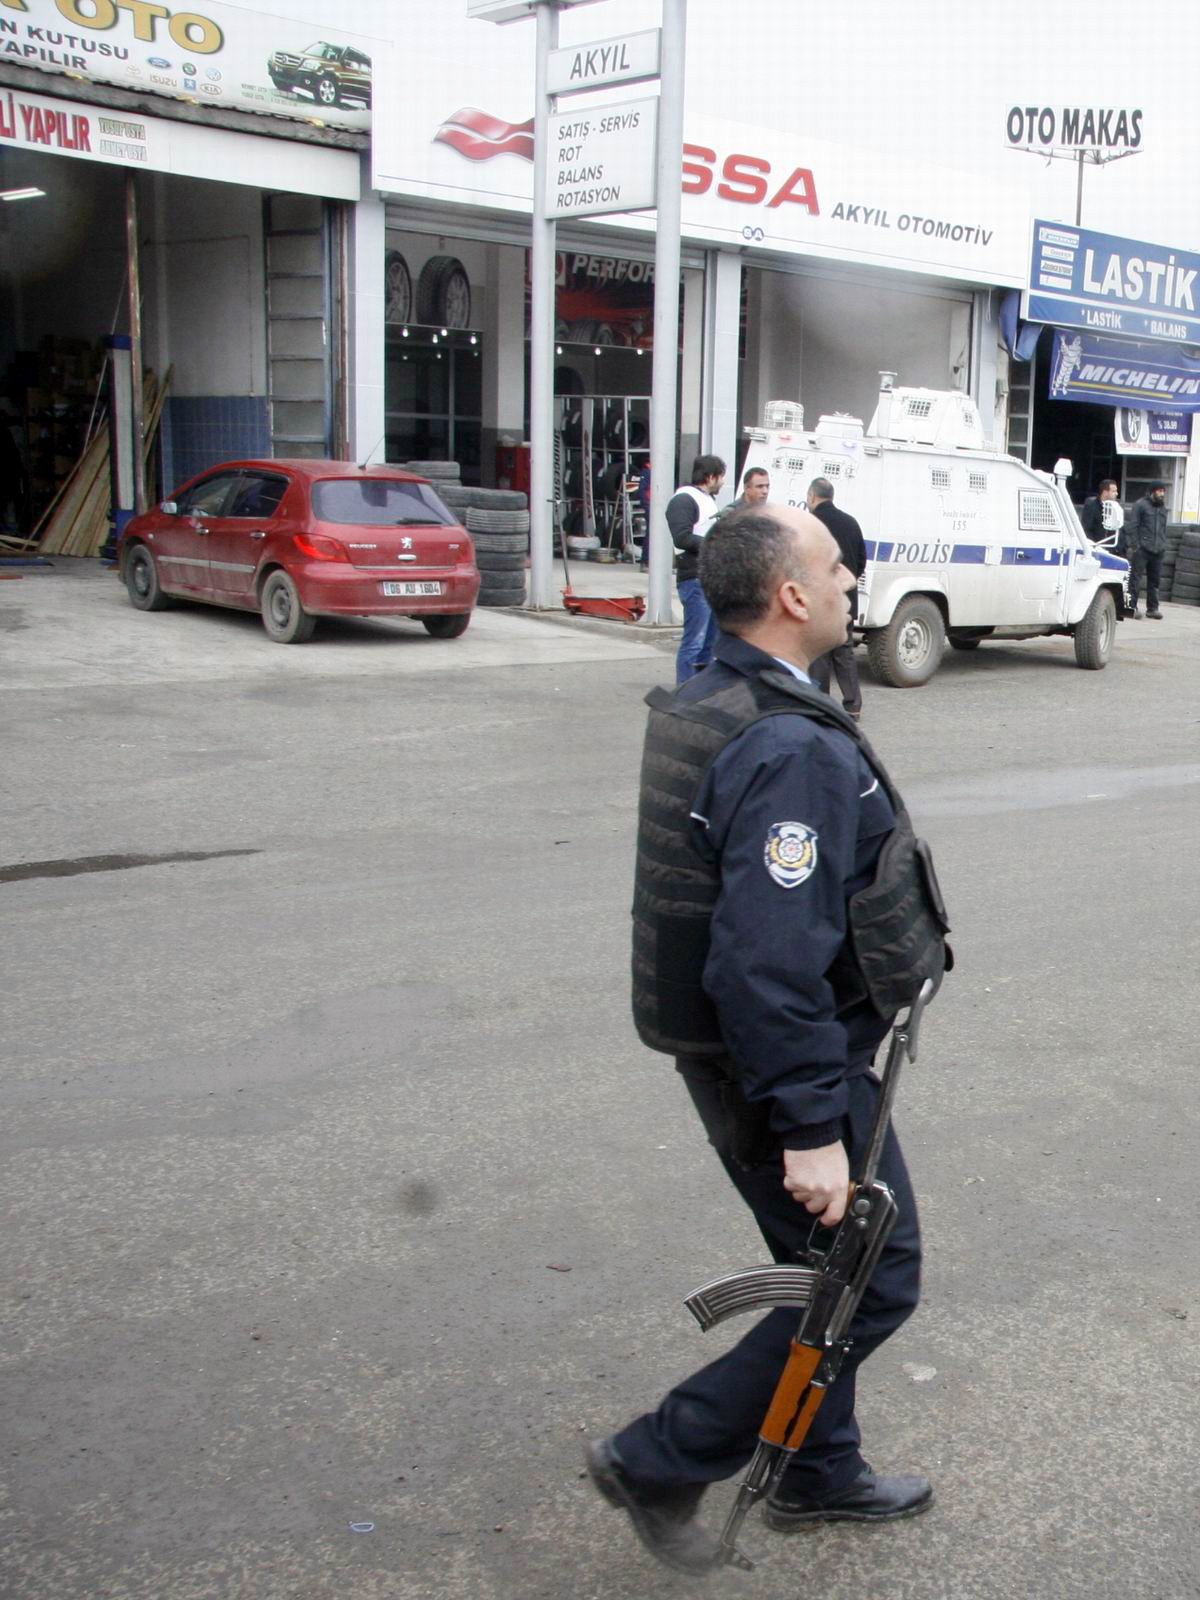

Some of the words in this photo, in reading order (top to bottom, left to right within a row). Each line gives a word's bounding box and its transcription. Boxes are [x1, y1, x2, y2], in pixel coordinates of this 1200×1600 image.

[0, 38, 88, 70] APILIR
[27, 25, 129, 60] KUTUSU
[569, 43, 631, 80] AKYIL
[18, 103, 92, 152] YAPILIR
[557, 120, 590, 142] SATIŞ
[599, 109, 641, 133] SERVİS
[1006, 106, 1055, 144] OTO
[1061, 108, 1143, 148] MAKAS
[557, 146, 582, 163] ROT
[556, 165, 603, 186] BALANS
[681, 142, 821, 217] SSA
[556, 185, 621, 208] ROTASYON
[830, 202, 892, 229] AKYIL
[896, 214, 995, 247] OTOMOTİV
[571, 253, 656, 285] PERFOR
[1082, 248, 1199, 312] LASTİK
[1087, 311, 1122, 329] LASTİK
[1151, 320, 1187, 339] BALANS
[1078, 363, 1200, 395] MICHELIN
[952, 520, 967, 531] 155
[893, 538, 951, 564] POLİS
